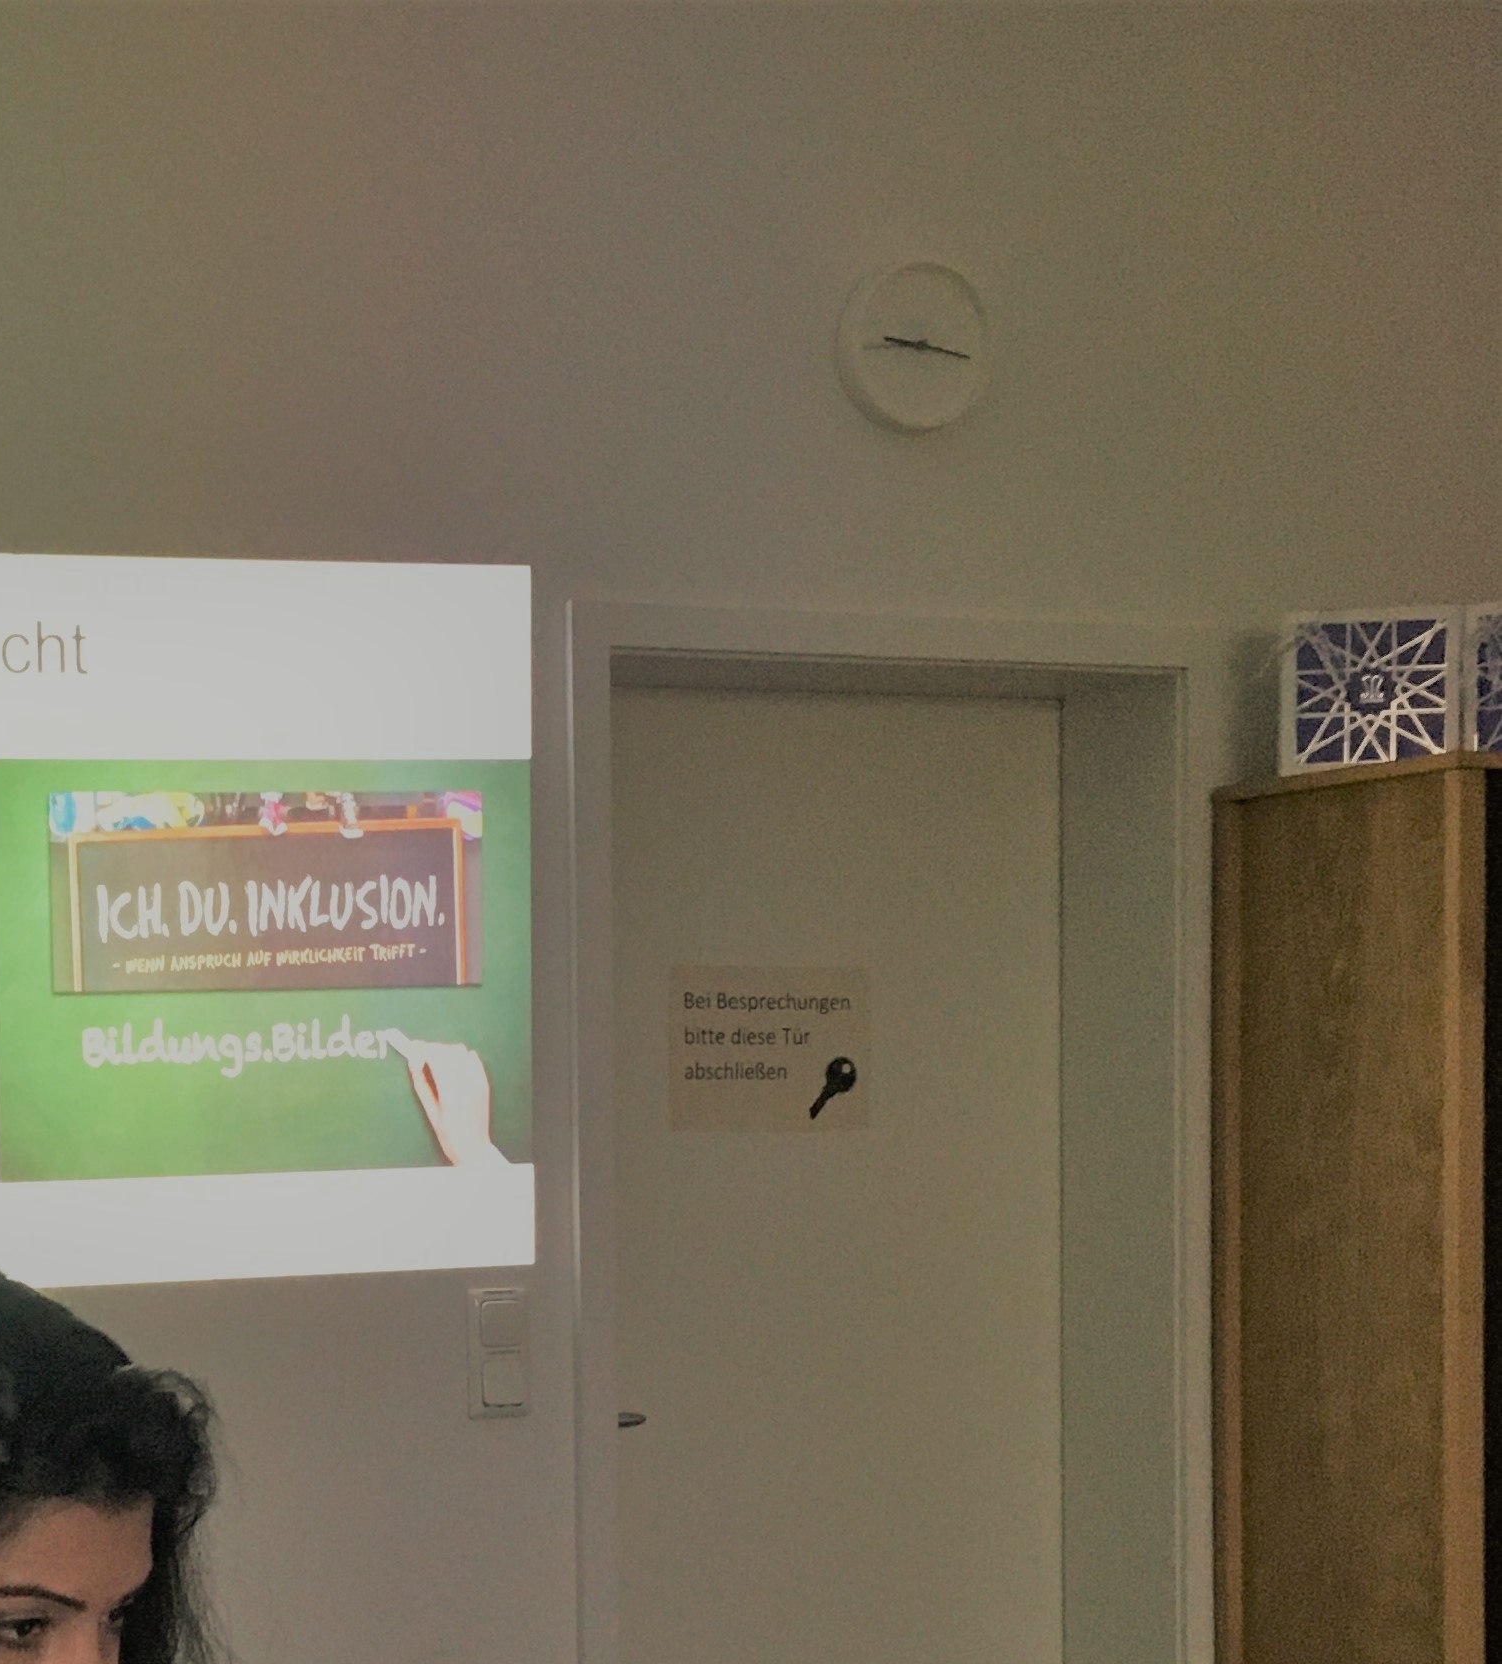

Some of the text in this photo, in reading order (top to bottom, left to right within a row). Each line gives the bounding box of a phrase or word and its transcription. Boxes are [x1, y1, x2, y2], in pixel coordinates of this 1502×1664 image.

[97, 874, 445, 943] ICH. DU. INKLUSION.
[126, 955, 165, 974] WENN
[171, 952, 241, 972] ANSPRUCH
[247, 949, 273, 967] AUF
[684, 991, 851, 1014] Bei Besprechungen
[82, 1014, 399, 1077] Bildungs.Bilder
[684, 1027, 811, 1045] bitte diese Tür
[684, 1062, 788, 1081] abschließen
